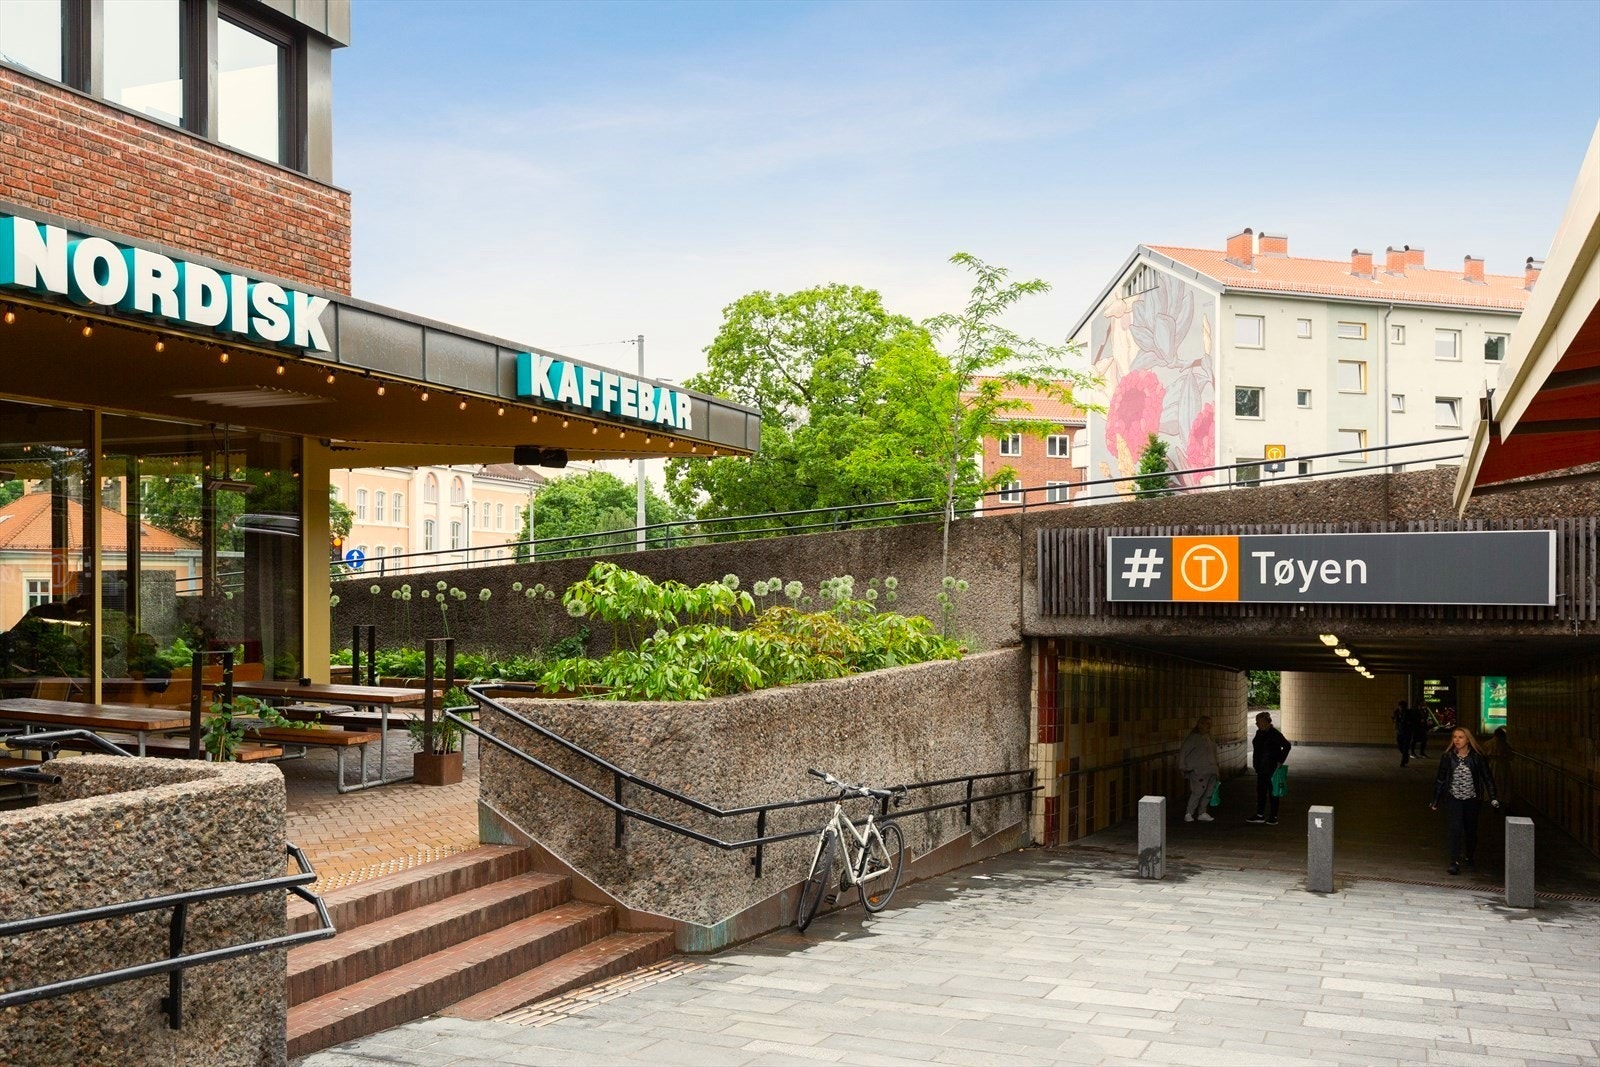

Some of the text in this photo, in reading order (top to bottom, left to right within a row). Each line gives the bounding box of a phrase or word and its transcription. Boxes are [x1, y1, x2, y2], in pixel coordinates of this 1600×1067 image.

[12, 215, 332, 353] NORDISK
[530, 352, 693, 431] KAFFEBAR
[1121, 548, 1164, 588] #
[1251, 551, 1367, 593] Tøyen
